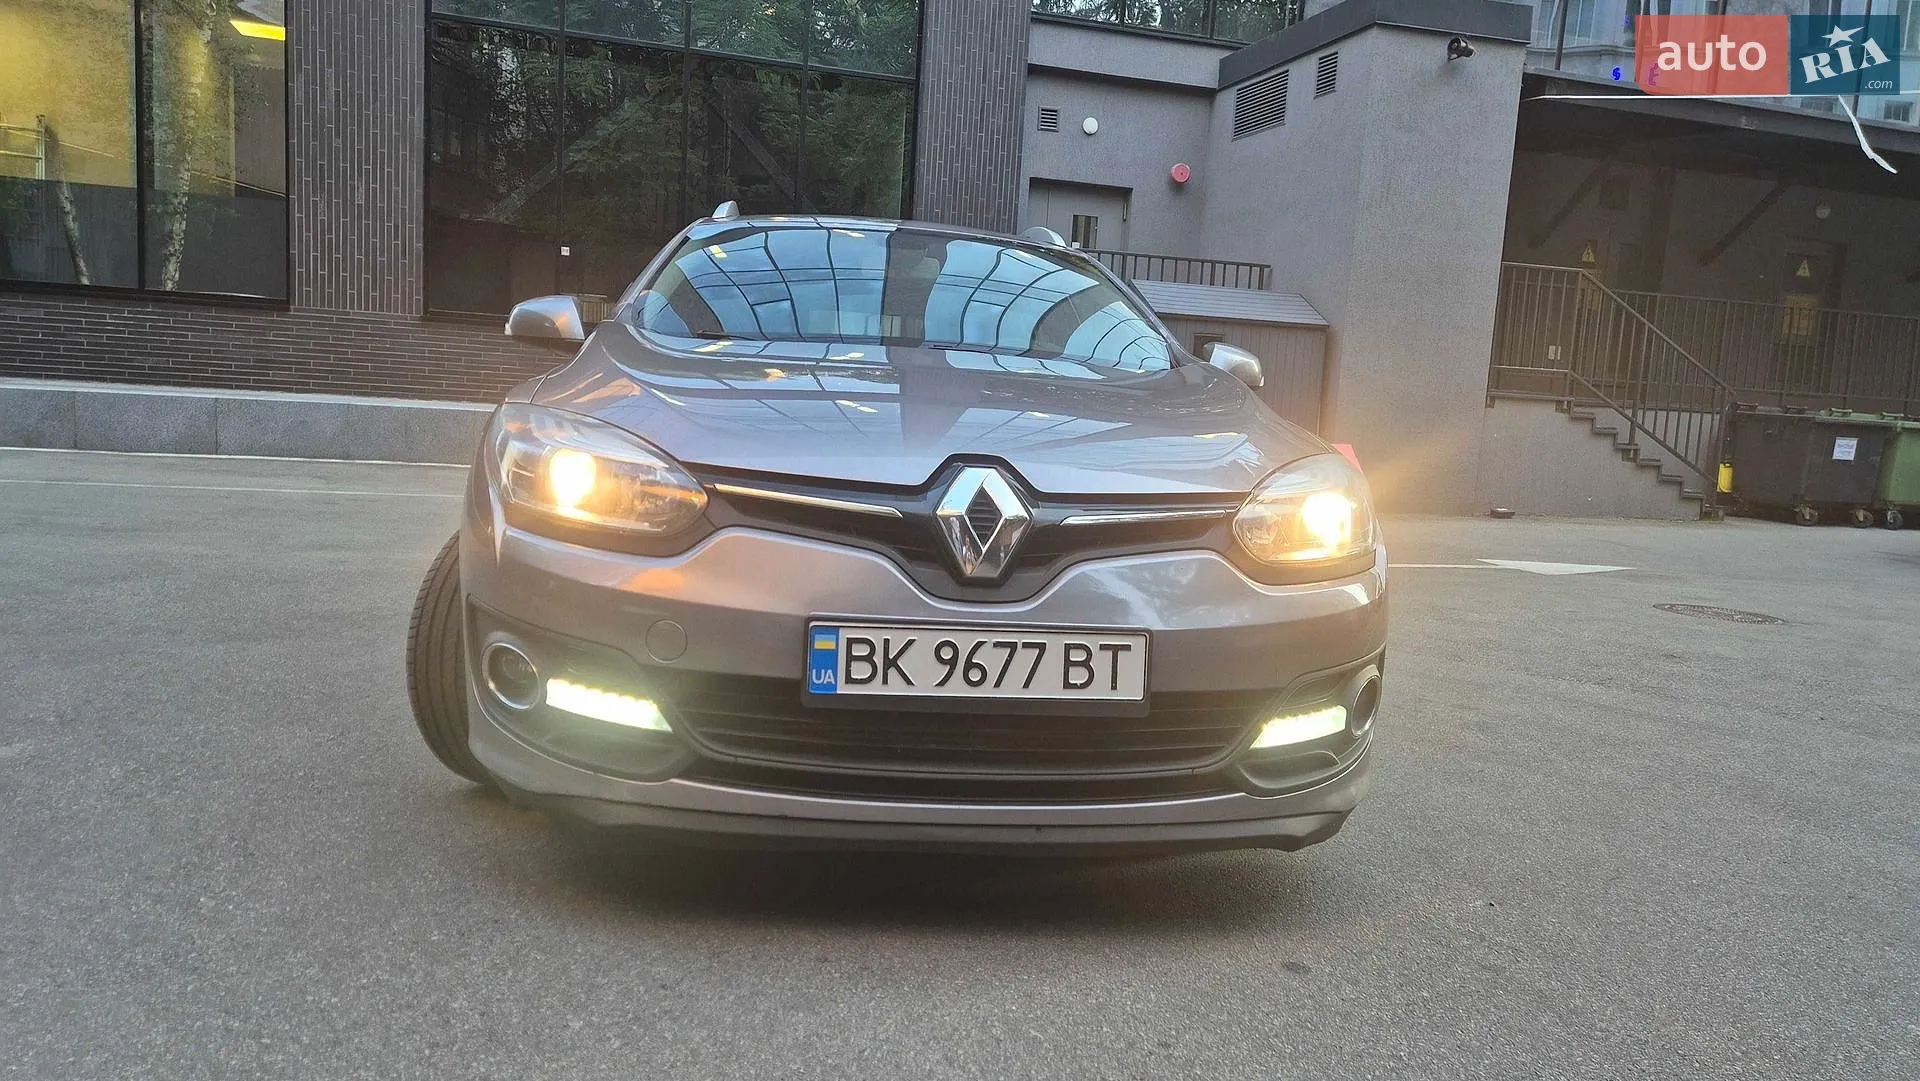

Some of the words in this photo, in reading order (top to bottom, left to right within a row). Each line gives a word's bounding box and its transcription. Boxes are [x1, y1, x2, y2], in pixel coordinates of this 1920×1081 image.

[812, 669, 835, 685] UA
[844, 636, 917, 686] BK
[933, 639, 1047, 689] 9677
[1062, 642, 1132, 690] BT
